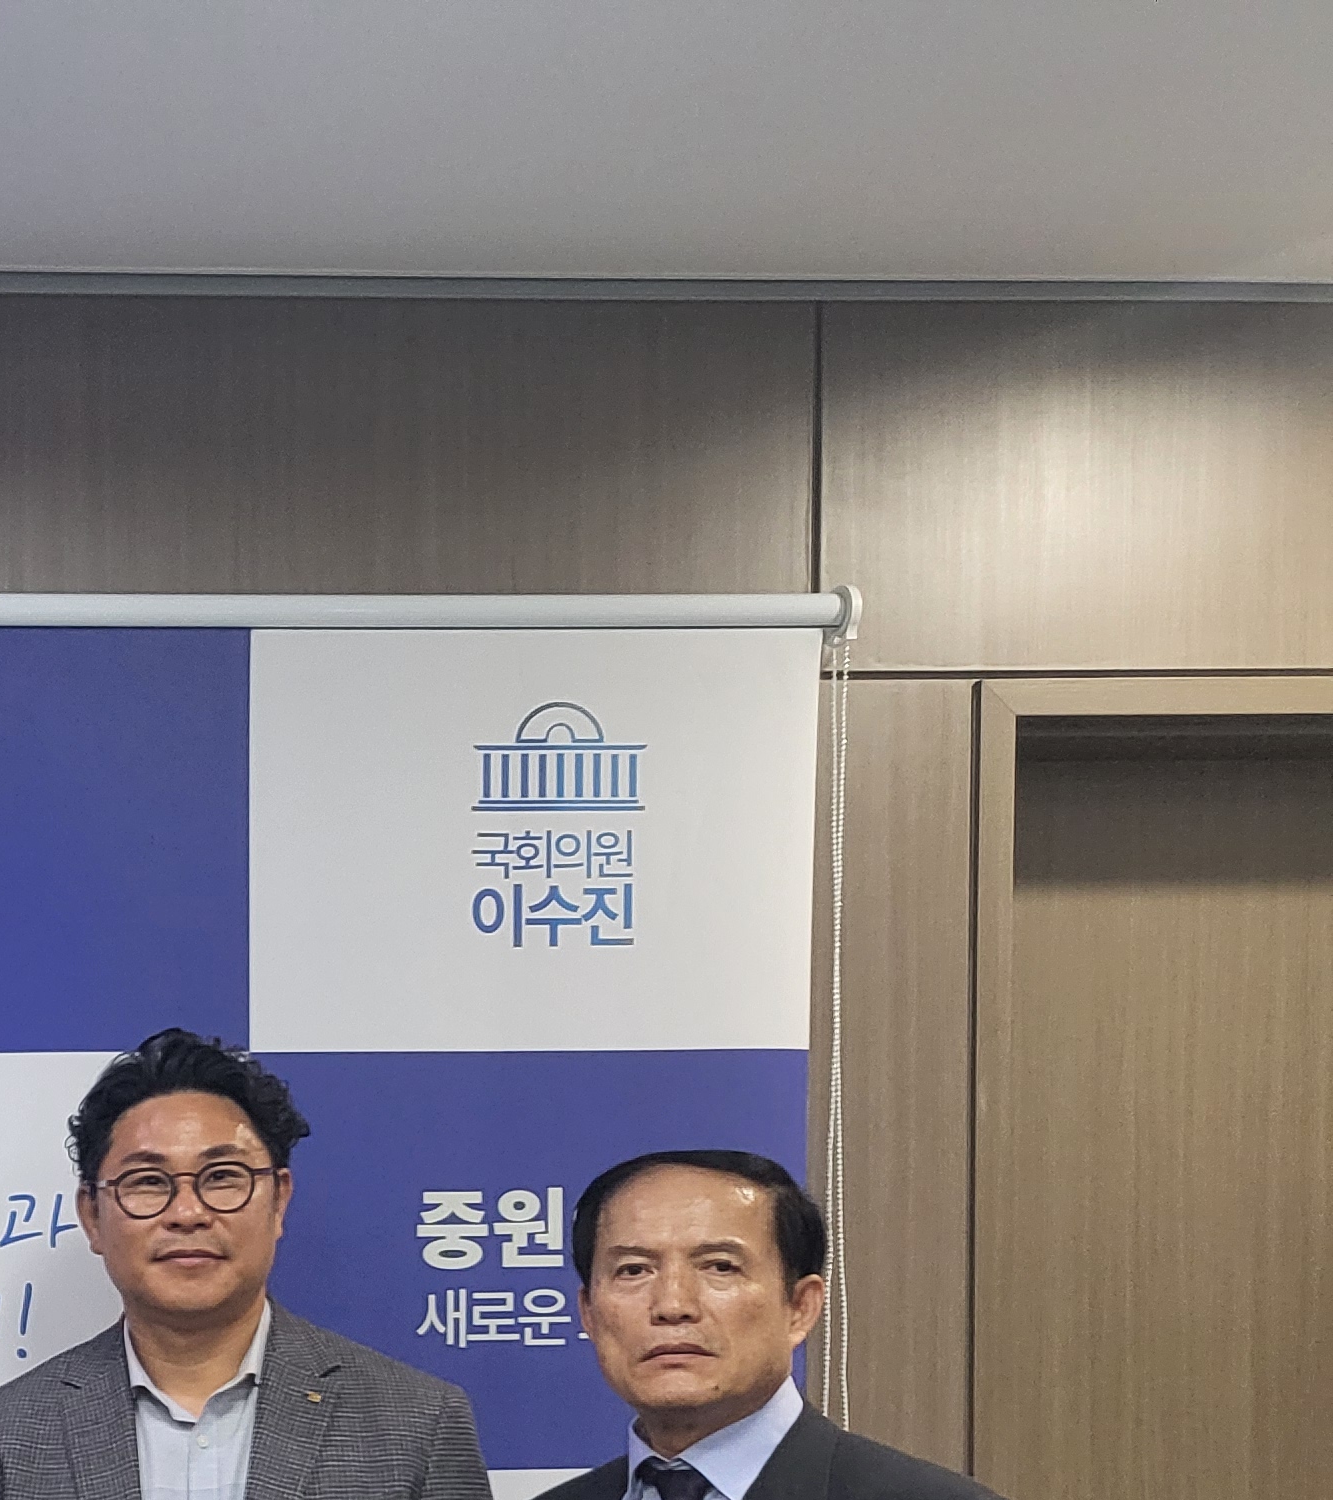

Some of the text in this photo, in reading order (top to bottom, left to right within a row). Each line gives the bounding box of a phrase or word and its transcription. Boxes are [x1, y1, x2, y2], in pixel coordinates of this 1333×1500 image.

[471, 830, 634, 879] 국회의원
[472, 883, 634, 947] 이수진
[416, 1187, 565, 1270] 중원
[416, 1288, 572, 1349] 새로운
